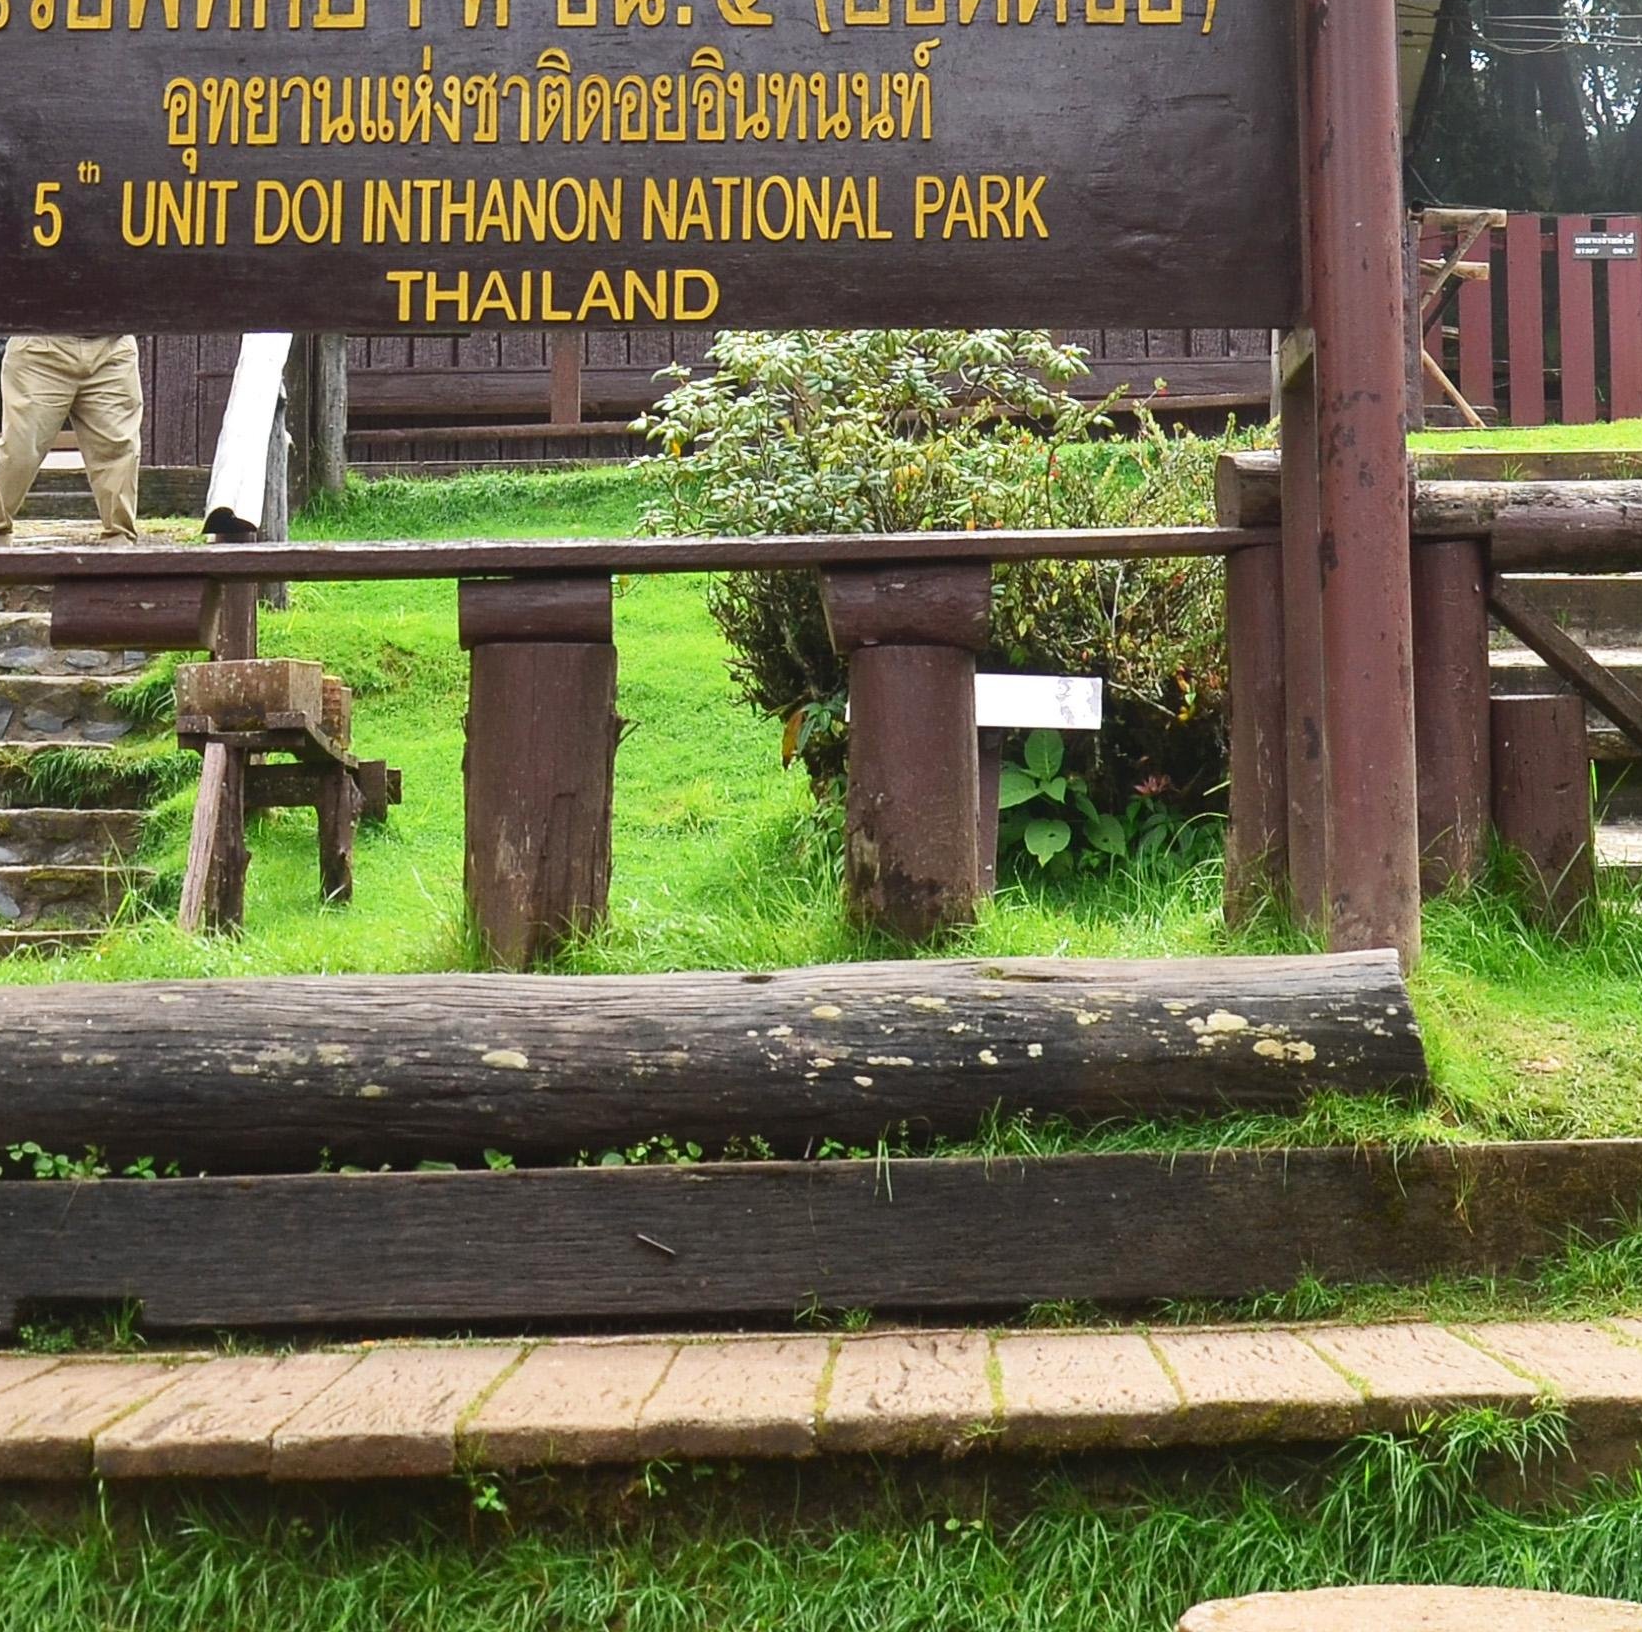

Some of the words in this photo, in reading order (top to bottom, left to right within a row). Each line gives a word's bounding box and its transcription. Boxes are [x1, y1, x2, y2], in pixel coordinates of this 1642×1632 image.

[162, 38, 939, 175] อุทยานแห่งชาติดอยอินทนนท์
[121, 179, 239, 247] UNIT
[253, 178, 343, 245] DOI
[362, 176, 623, 244] INTHANON
[642, 174, 892, 242] NATIONAL
[914, 174, 1049, 240] PARK
[386, 268, 720, 323] THAILAND
